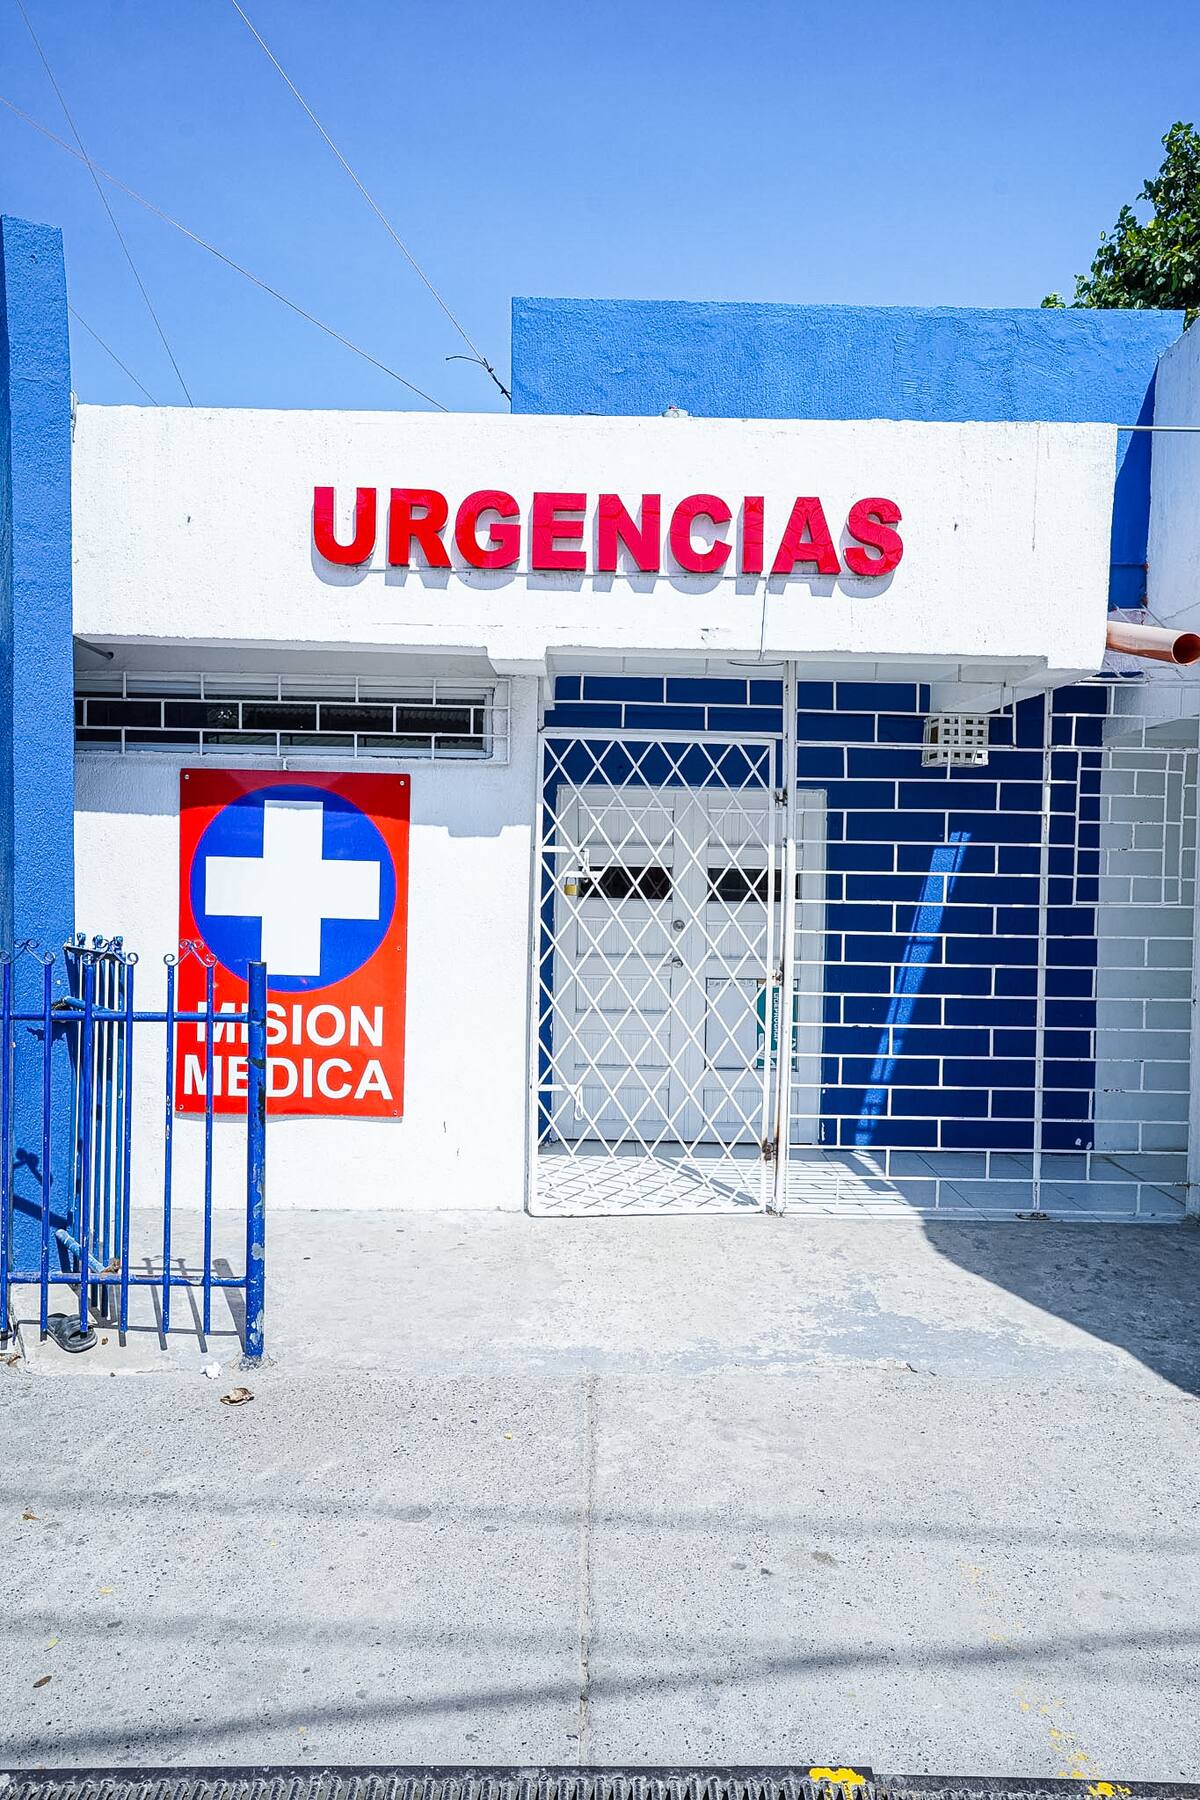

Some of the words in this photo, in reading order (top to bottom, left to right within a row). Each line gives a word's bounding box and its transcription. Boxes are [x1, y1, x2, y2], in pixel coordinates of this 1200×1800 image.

[313, 486, 903, 576] URGENCIAS
[197, 1001, 384, 1047] MISION
[184, 1054, 393, 1100] MEDICA
